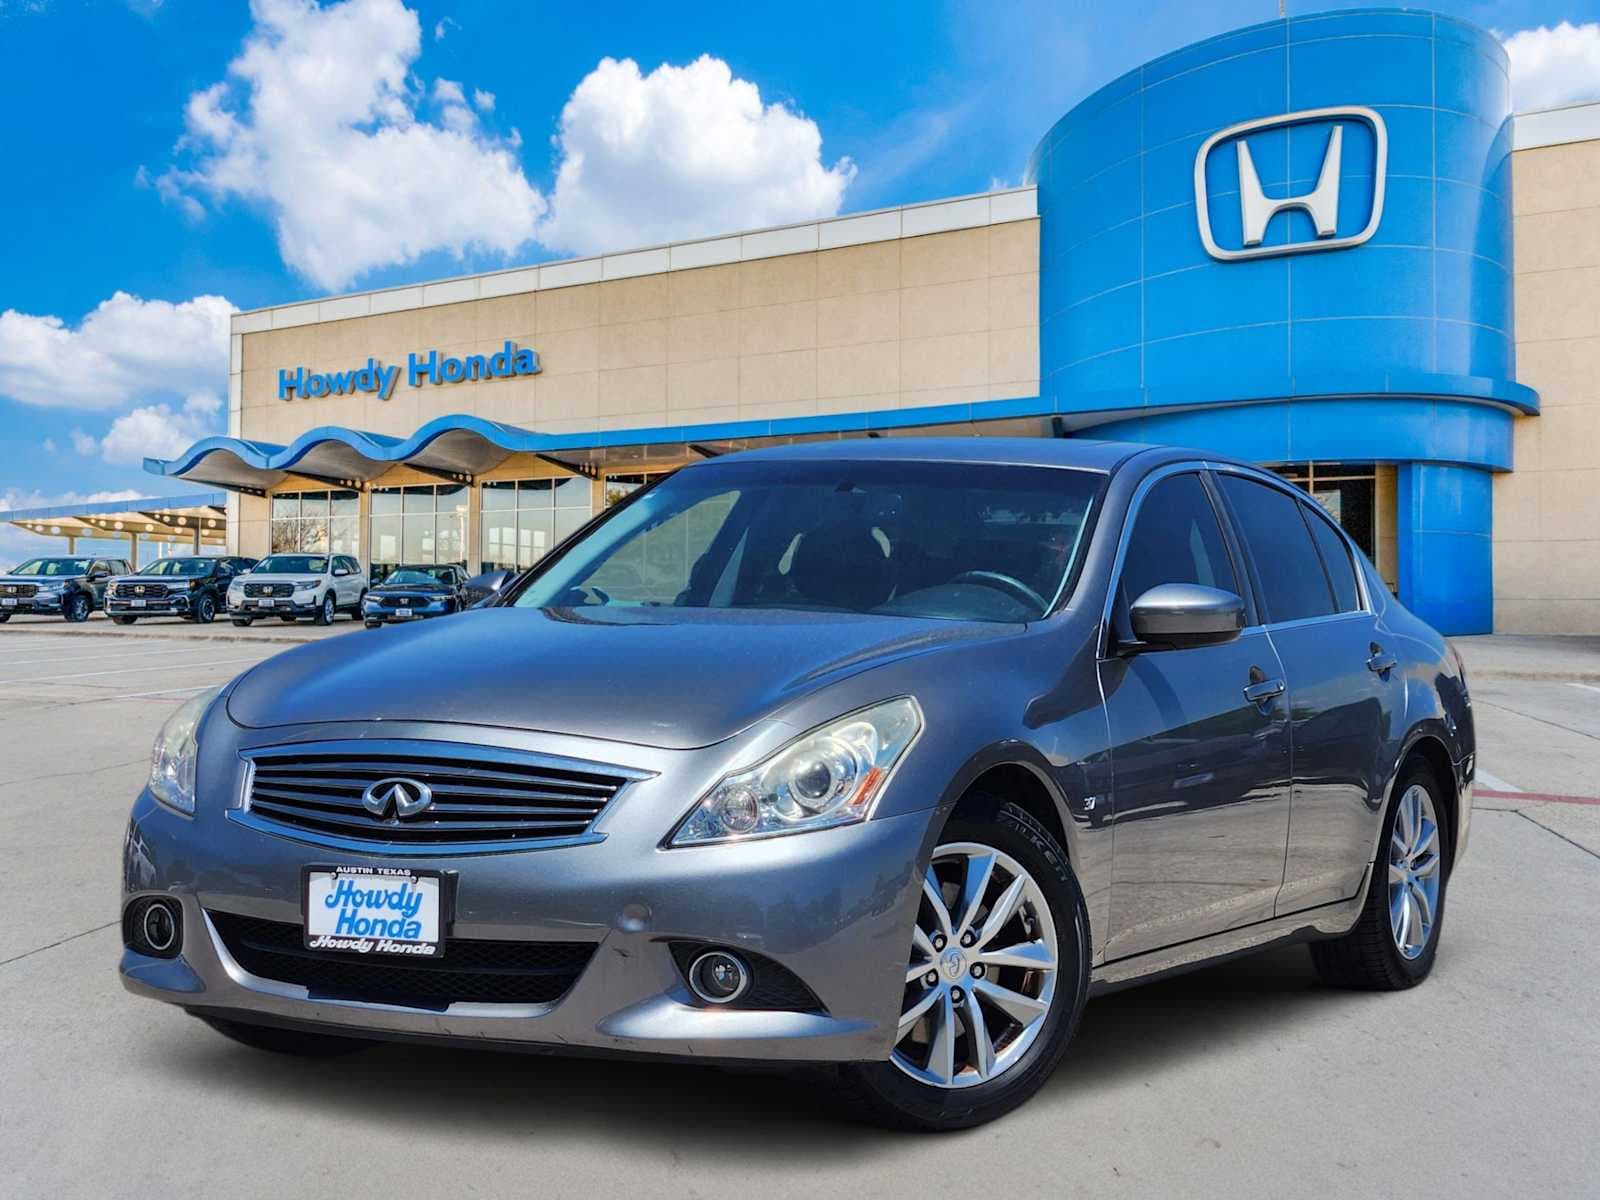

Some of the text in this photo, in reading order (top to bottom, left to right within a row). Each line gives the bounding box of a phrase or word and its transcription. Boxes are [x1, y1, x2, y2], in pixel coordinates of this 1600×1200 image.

[278, 340, 542, 401] Howdy Honda
[325, 879, 423, 918] Howdy
[335, 908, 422, 939] Honda
[309, 935, 436, 955] Howdy Honda
